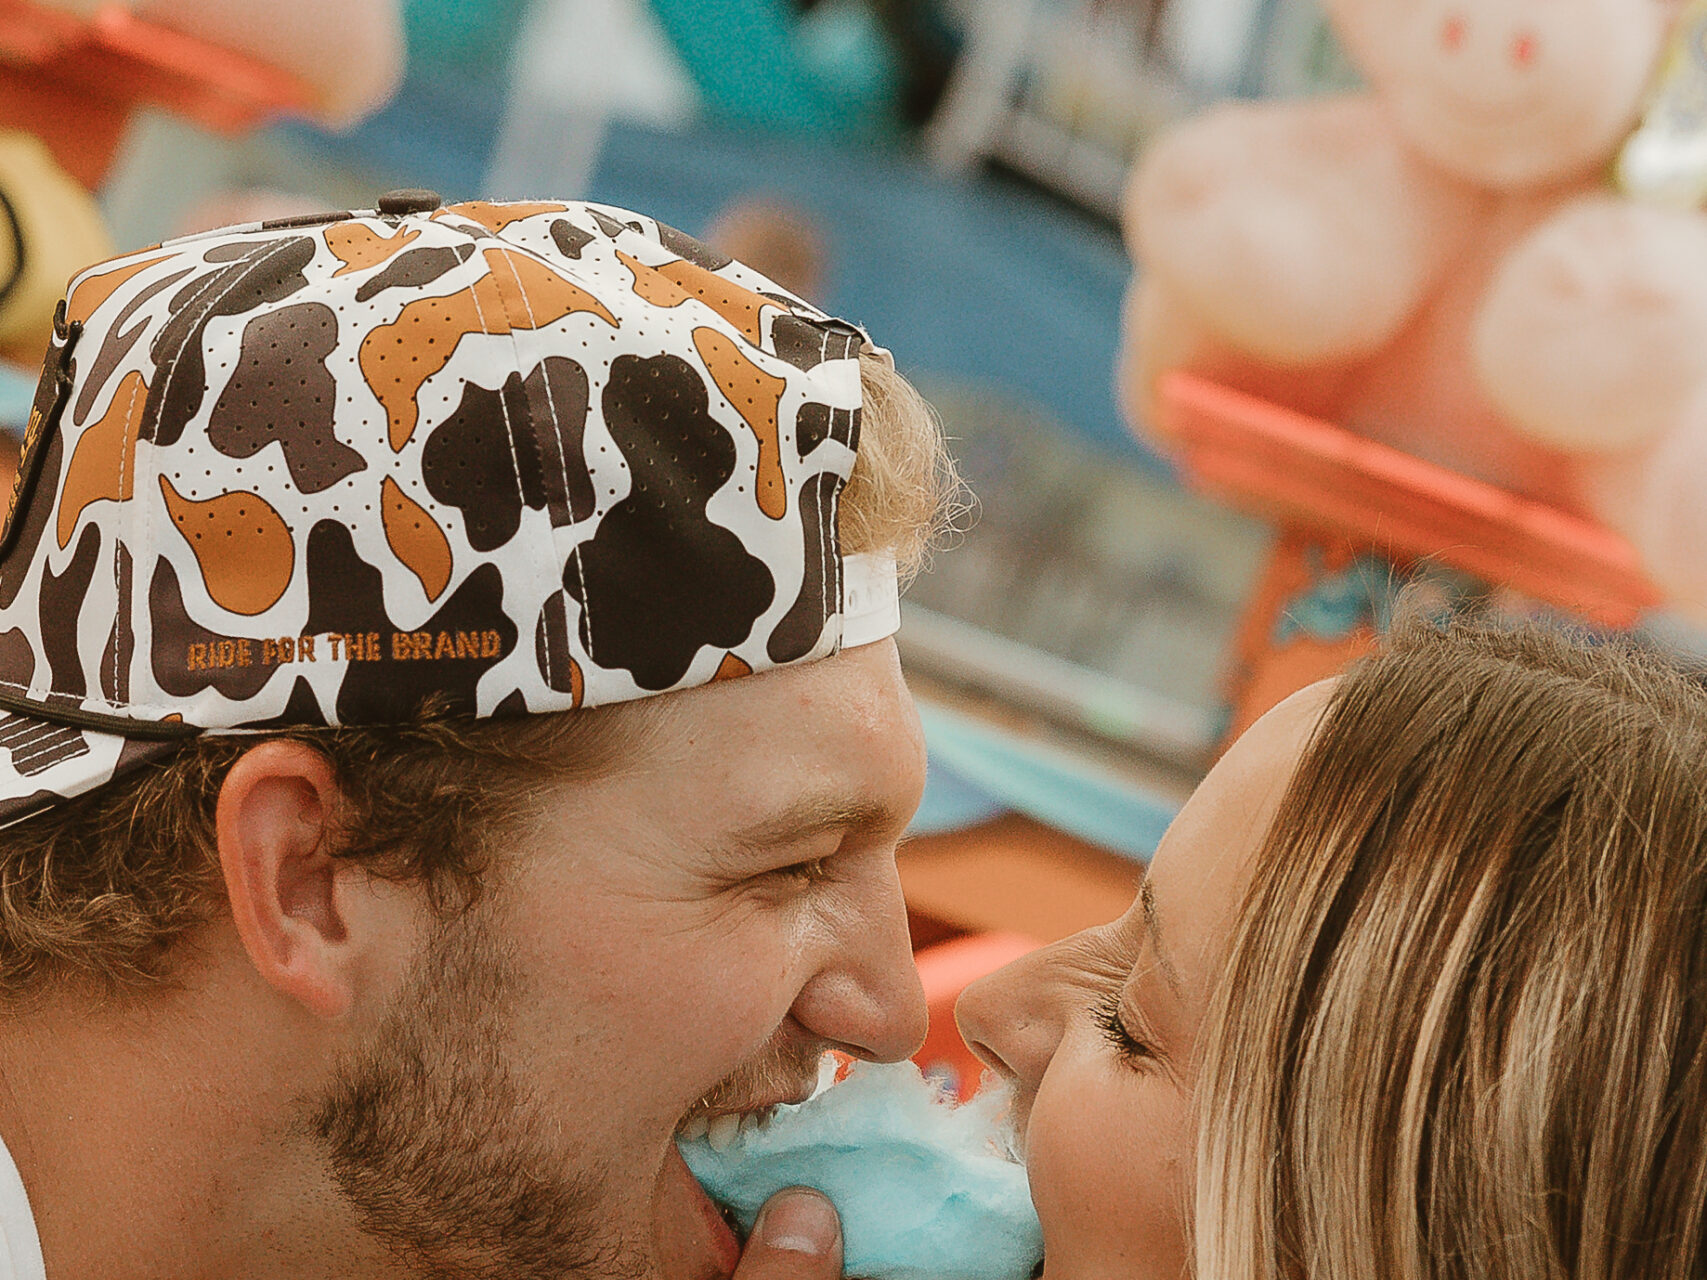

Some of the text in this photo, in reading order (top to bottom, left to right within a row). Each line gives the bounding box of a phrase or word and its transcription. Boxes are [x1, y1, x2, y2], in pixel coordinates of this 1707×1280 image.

[188, 630, 501, 671] RIDE FOR THE BRAND
